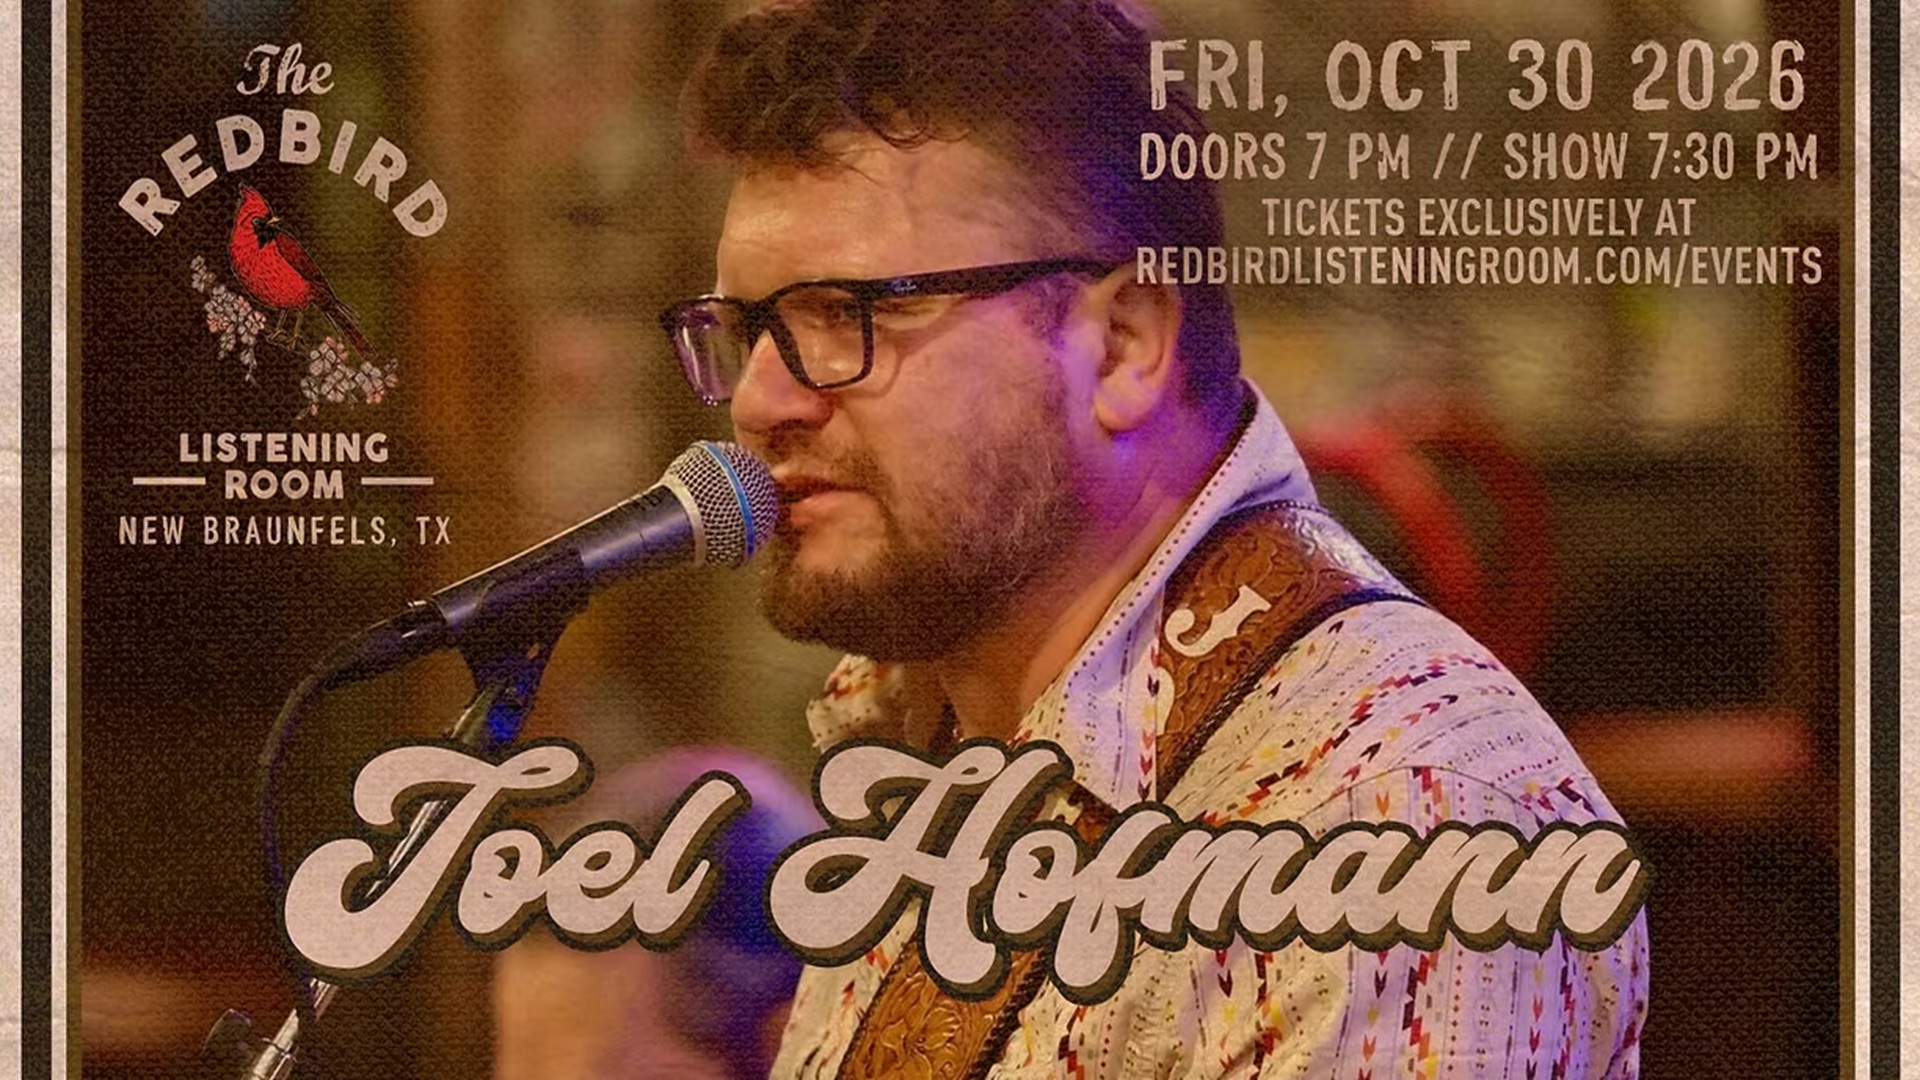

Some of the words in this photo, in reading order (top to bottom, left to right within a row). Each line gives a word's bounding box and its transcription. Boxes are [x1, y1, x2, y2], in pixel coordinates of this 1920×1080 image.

[236, 43, 334, 95] The
[1149, 39, 1289, 118] FRI,
[1326, 39, 1471, 112] OCT
[1508, 39, 1594, 112] 30
[1631, 39, 1806, 112] 2026
[118, 109, 448, 237] REDBIRD
[1140, 132, 1287, 181] DOORS
[1306, 133, 1327, 180] 7
[1348, 132, 1411, 181] PM
[1503, 132, 1628, 181] SHOW
[1649, 132, 1735, 181] 7:30
[1756, 132, 1819, 181] PM
[1263, 199, 1406, 238] TICKETS
[1418, 199, 1642, 238] EXCLUSIVELY
[1655, 199, 1696, 237] AT
[1136, 244, 1823, 286] REDBIRDLISTENINGROOM.COM/EVENTS
[179, 432, 389, 463] LISTENING
[224, 469, 344, 500] ROOM
[118, 516, 184, 545] NEW
[203, 516, 397, 547] BRAUNFELS,
[416, 516, 451, 545] TX
[285, 744, 750, 980] Joel
[770, 740, 1645, 1003] Hofmann
